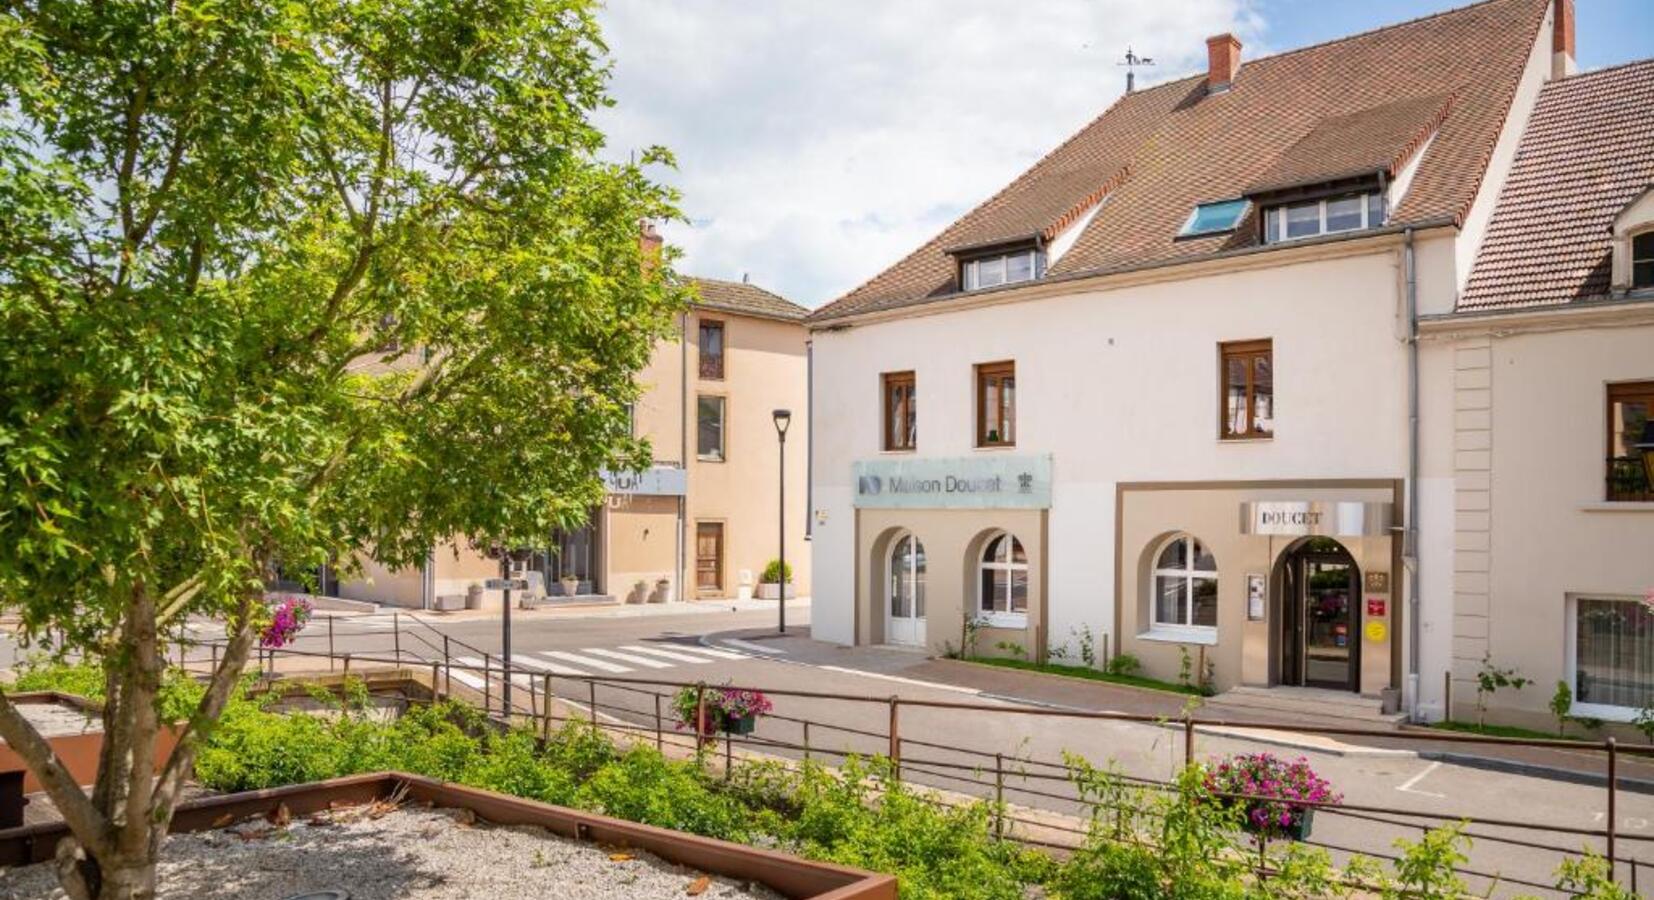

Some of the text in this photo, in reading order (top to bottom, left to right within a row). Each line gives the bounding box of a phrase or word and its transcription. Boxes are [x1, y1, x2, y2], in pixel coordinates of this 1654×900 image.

[889, 476, 941, 493] Maison
[946, 475, 1001, 493] Doucet
[1262, 511, 1323, 525] DOUCET
